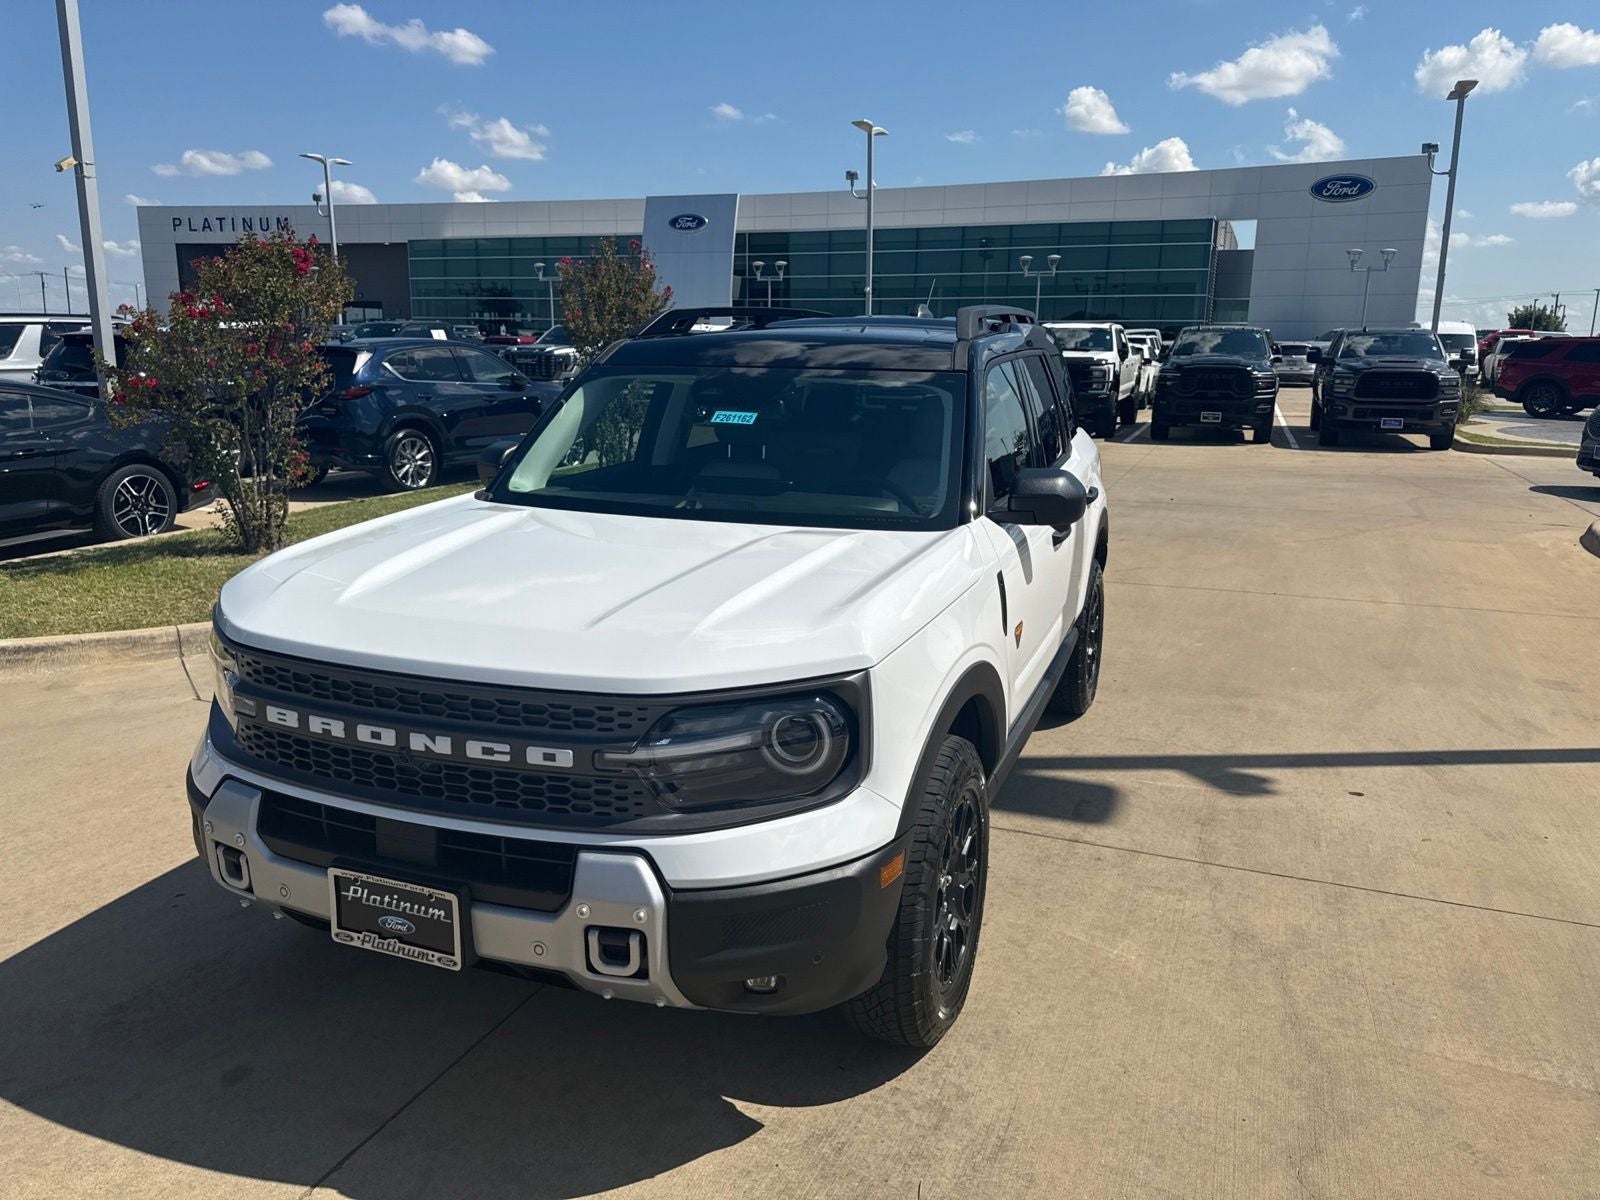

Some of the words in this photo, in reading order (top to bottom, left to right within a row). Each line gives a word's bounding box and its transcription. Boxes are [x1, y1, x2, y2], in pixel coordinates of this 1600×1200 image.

[1322, 180, 1360, 196] Ford
[172, 217, 289, 232] PLATINUM
[676, 216, 698, 229] Ford
[714, 413, 754, 423] F261162
[266, 705, 574, 767] BRONCO
[341, 885, 452, 923] Platinum
[385, 917, 409, 932] Ford
[361, 934, 435, 962] Platinum
